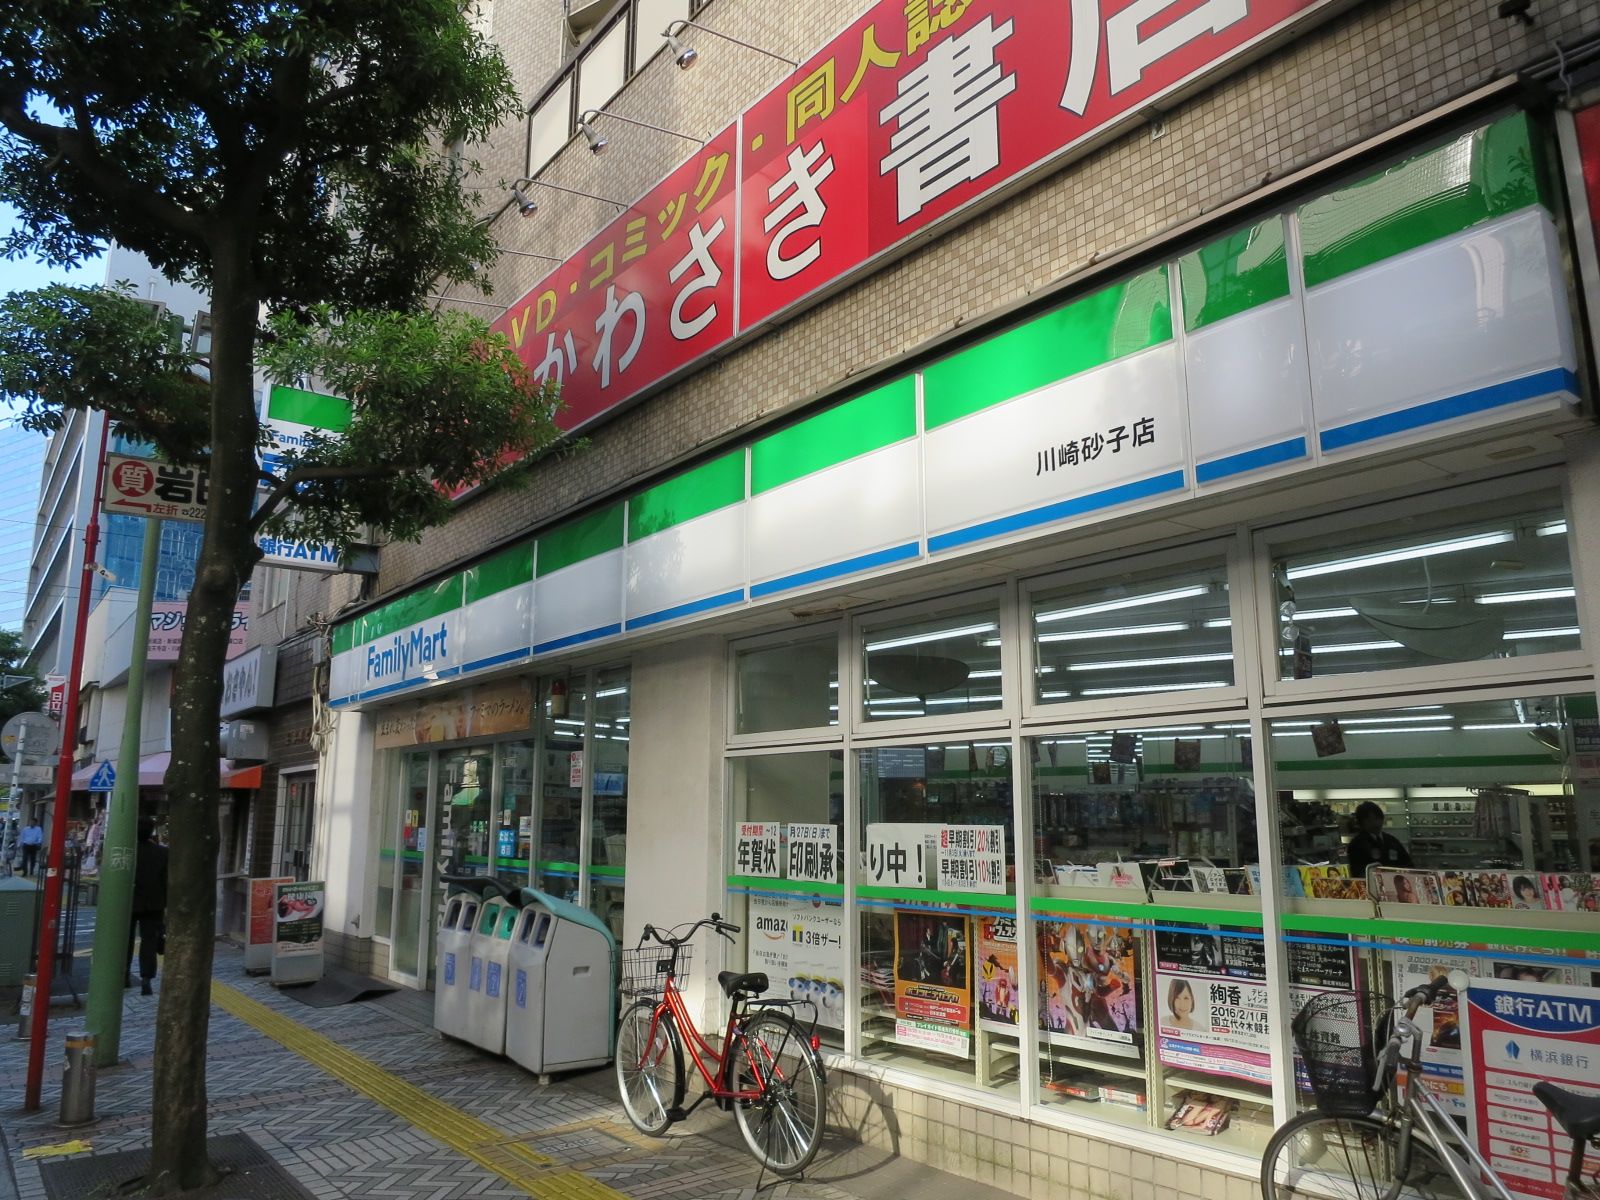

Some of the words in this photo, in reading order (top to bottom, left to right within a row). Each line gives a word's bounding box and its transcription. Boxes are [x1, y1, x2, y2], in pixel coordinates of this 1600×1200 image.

[1036, 417, 1155, 476] 川崎砂子店
[119, 464, 149, 493] 質
[153, 503, 179, 515] 左折
[259, 537, 339, 563] 銀行ATM
[367, 622, 447, 680] FamilyMart
[738, 838, 777, 874] 年賀状
[789, 840, 834, 880] 印刷承
[756, 916, 789, 932] amaz
[1210, 984, 1241, 1006] 絢香
[1211, 1006, 1268, 1023] 2016/2/1(月
[1494, 994, 1592, 1024] 銀行ATM
[1530, 1048, 1589, 1069] 横浜銀行
